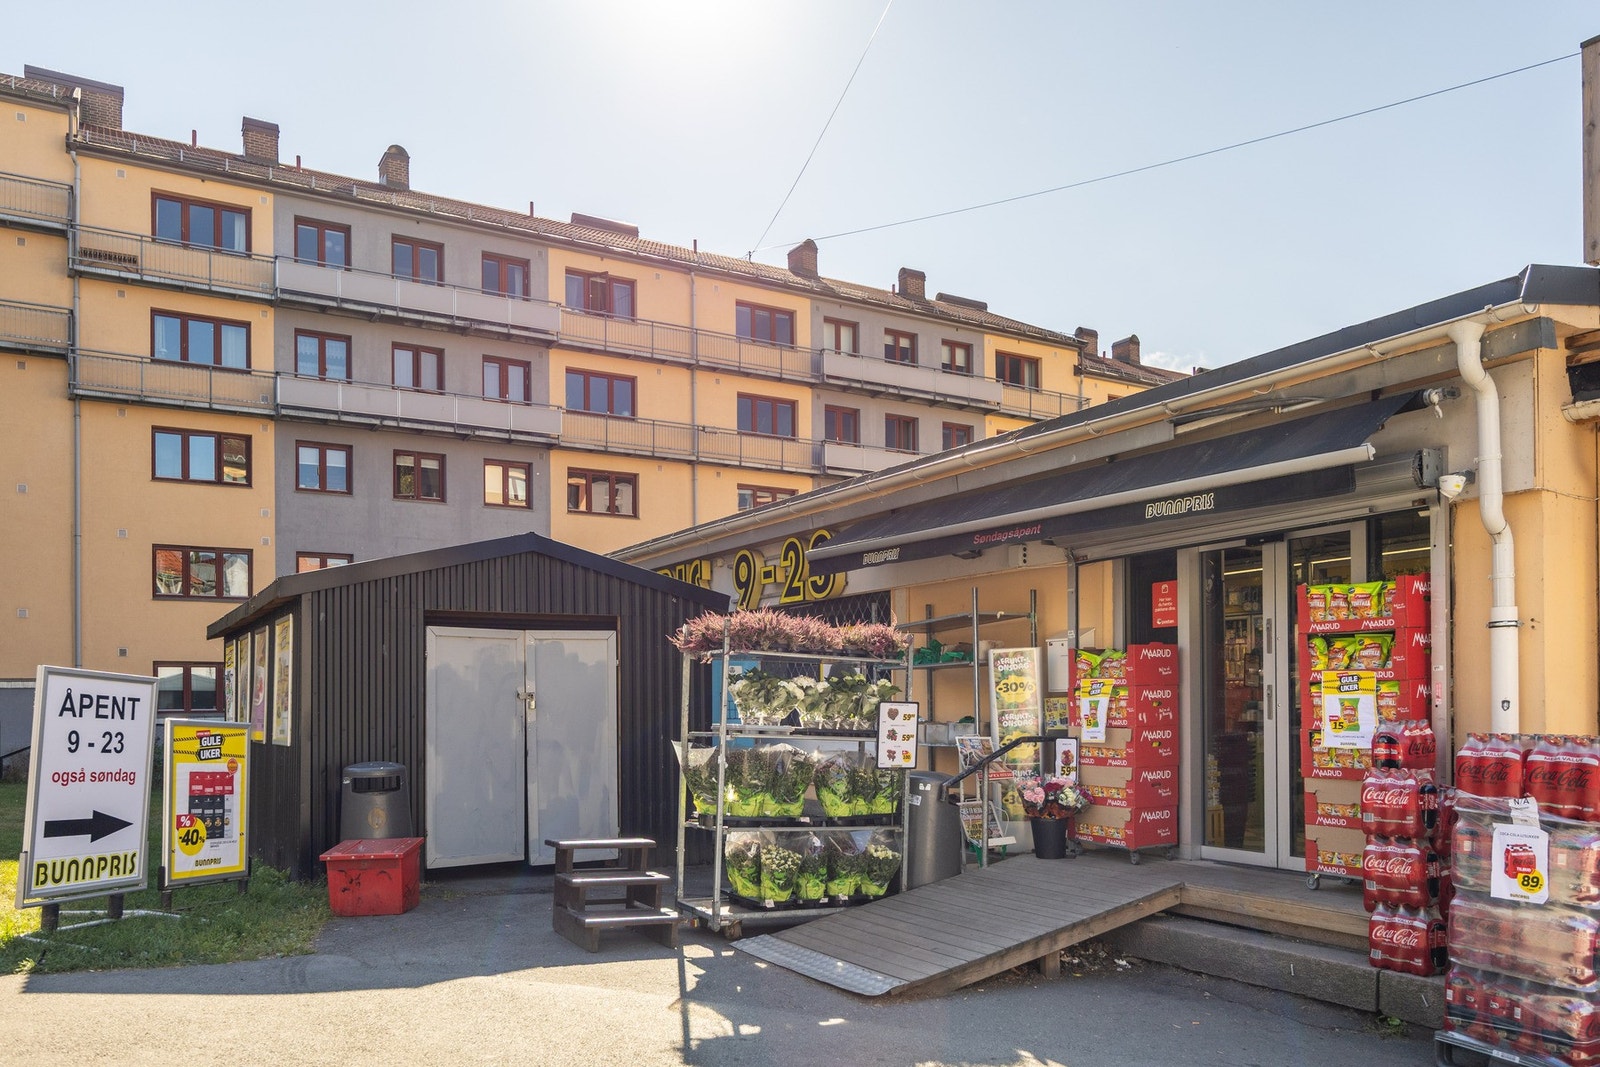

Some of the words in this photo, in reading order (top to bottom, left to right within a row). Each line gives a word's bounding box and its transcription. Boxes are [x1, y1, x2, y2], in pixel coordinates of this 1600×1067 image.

[1145, 492, 1214, 518] BUNNPRIS
[973, 524, 1041, 544] Søndagsåpent
[1309, 622, 1340, 632] MAARUD
[1361, 619, 1394, 629] MAARUD
[1140, 648, 1171, 659] MAARUD
[998, 662, 1029, 672] ONSDAG
[998, 681, 1033, 693] -30%
[1340, 684, 1358, 692] UKER
[1141, 690, 1172, 701] MAARUD
[58, 688, 140, 720] ÅPENT
[201, 735, 221, 747] GULE
[1141, 730, 1172, 741] MAARUD
[67, 730, 80, 753] 9
[101, 731, 124, 754] 23
[200, 748, 220, 759] UKER
[51, 768, 86, 786] også
[90, 768, 136, 785] søndag
[1013, 769, 1034, 777] RUKT-
[1140, 771, 1171, 782] MAARUD
[1312, 769, 1342, 777] MAARUD
[1514, 798, 1529, 806] N/A
[1139, 810, 1170, 823] MAARUD
[1316, 816, 1347, 826] MAARUD
[179, 828, 205, 846] -40%
[1106, 838, 1126, 846] MAARUD
[194, 858, 222, 867] BUNNPRIS
[34, 851, 138, 888] BUNNPRIS
[1317, 865, 1347, 875] MAARUD
